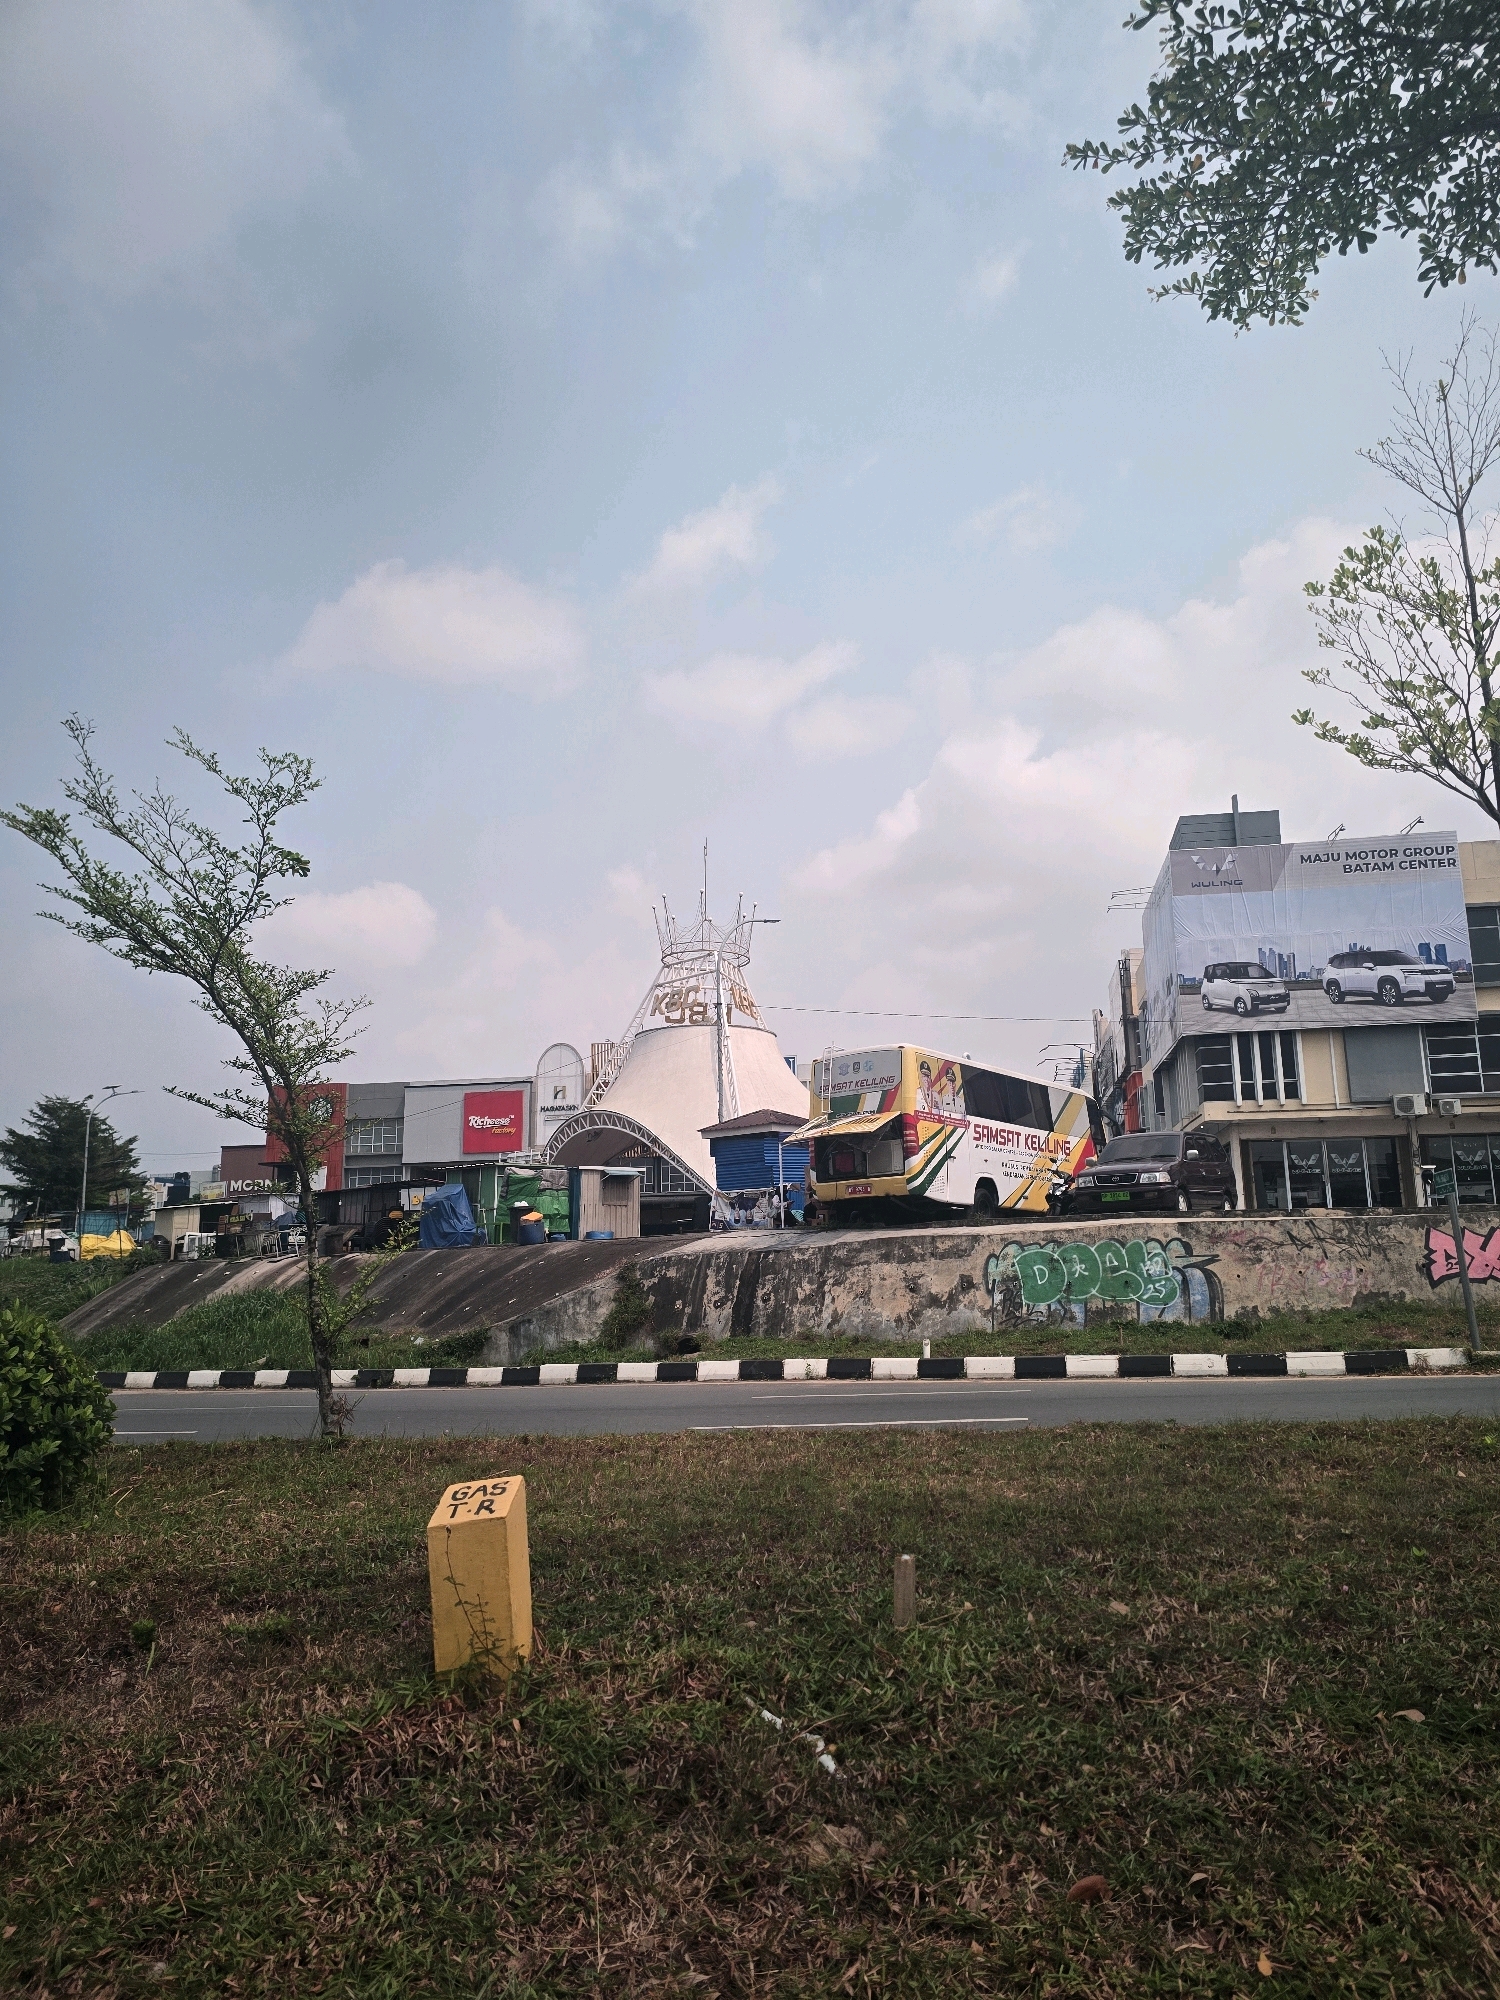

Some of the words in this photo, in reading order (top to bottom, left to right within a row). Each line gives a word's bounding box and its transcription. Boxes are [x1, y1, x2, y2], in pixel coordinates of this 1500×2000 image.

[1300, 852, 1341, 864] MAJU
[1345, 848, 1399, 861] MOTOR
[1403, 845, 1456, 858] GROUP
[1343, 861, 1395, 874] BATAM
[1399, 858, 1457, 870] CENTER
[1191, 879, 1243, 888] WULING
[650, 984, 701, 1016] KBC
[855, 1076, 896, 1087] KELILING
[468, 1114, 511, 1129] Richeese
[491, 1126, 517, 1136] Factory
[973, 1123, 1022, 1149] SAMSAT
[1024, 1133, 1071, 1157] KELILING
[451, 1480, 510, 1501] GAS
